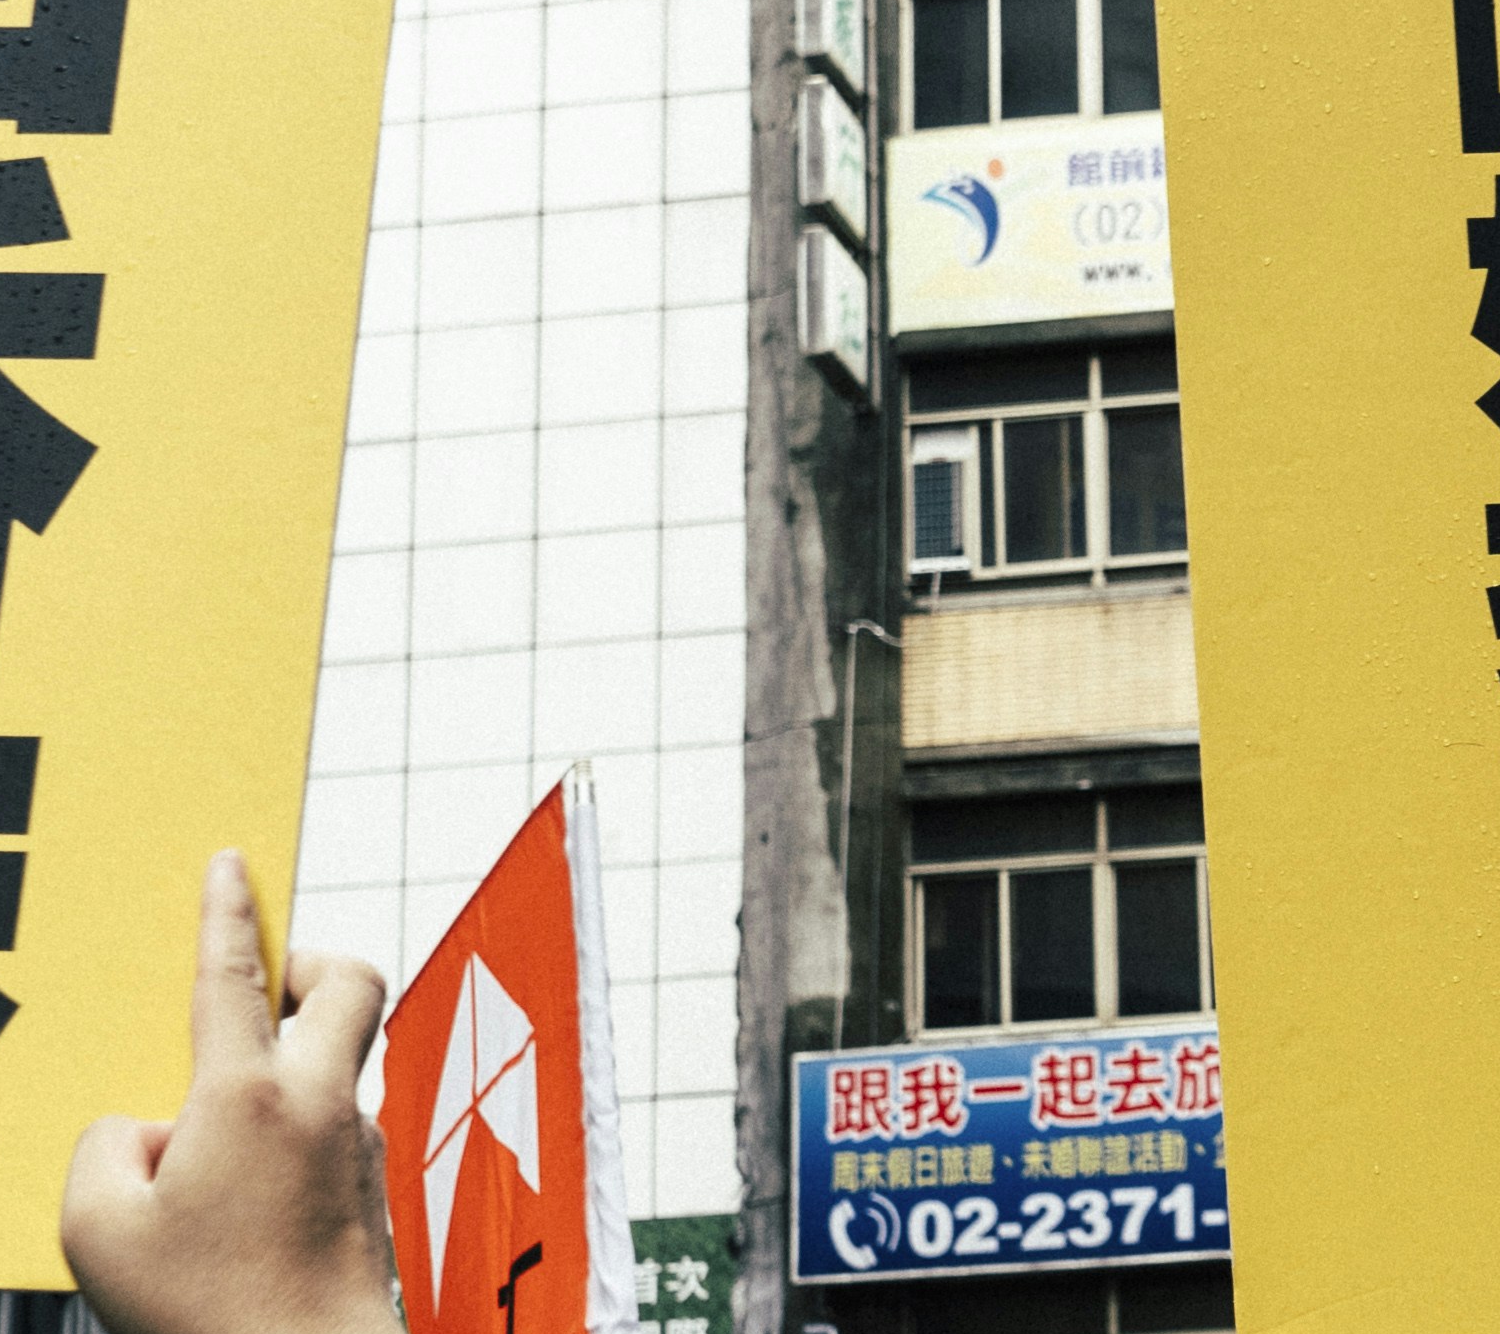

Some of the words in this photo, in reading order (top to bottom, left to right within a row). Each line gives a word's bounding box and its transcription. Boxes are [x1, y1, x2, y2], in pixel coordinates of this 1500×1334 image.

[830, 1043, 1222, 1137] 跟我一起去旅
[908, 1184, 1226, 1258] 02-2371-
